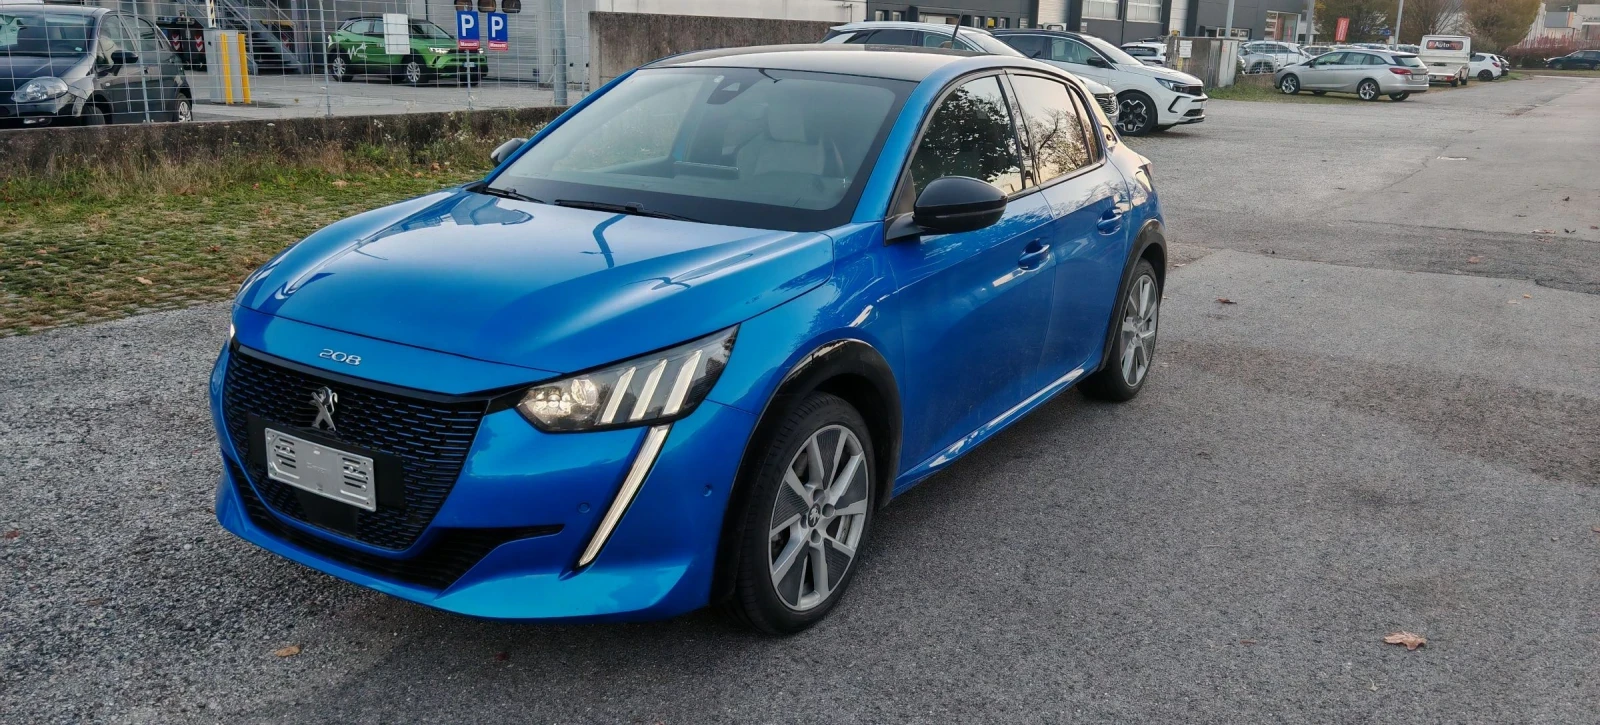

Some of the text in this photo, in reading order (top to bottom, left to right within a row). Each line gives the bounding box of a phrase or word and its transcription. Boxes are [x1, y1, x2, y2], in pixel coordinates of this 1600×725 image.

[461, 14, 475, 37] P
[491, 16, 504, 38] P
[319, 348, 362, 366] 208
